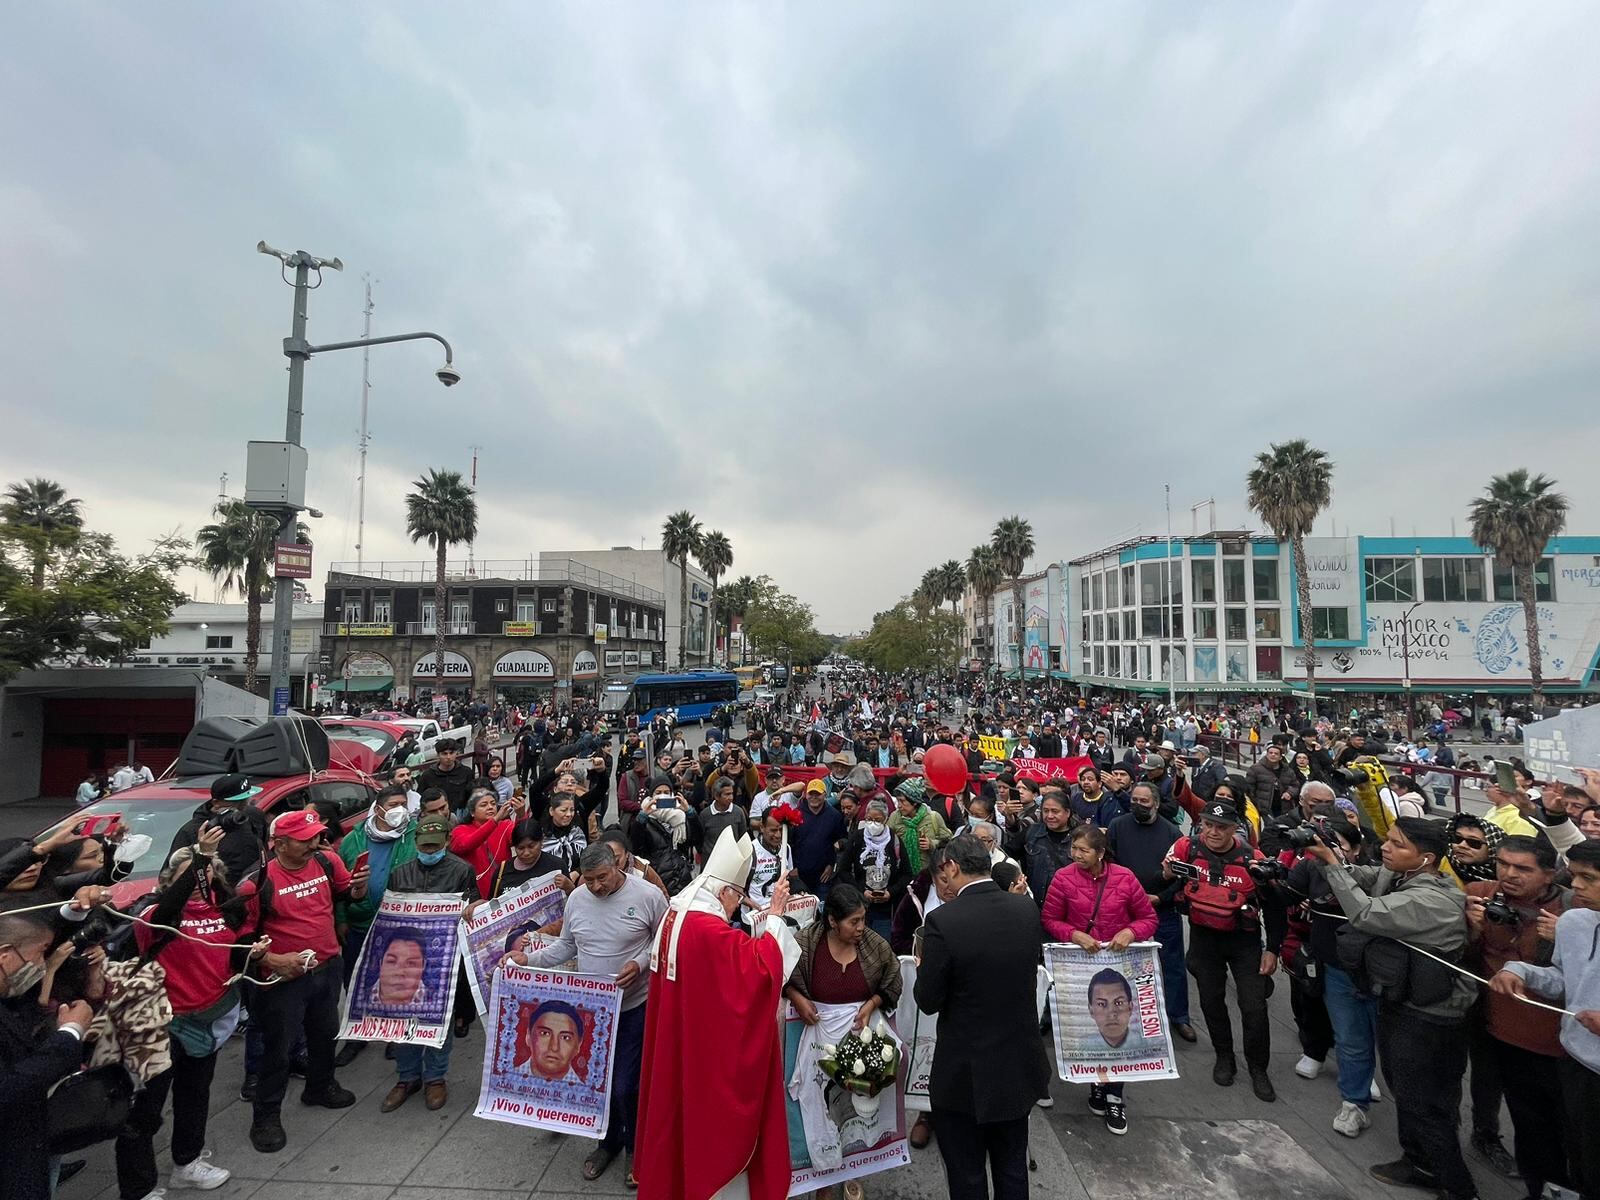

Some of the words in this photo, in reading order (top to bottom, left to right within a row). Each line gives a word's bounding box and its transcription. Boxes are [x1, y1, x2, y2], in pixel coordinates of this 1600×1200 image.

[1382, 619, 1440, 633] AMOR
[417, 663, 469, 673] ZAPTERIA
[496, 662, 550, 673] GUADALUPE
[575, 661, 597, 672] ZAPATERIA
[403, 902, 412, 912] lo
[415, 902, 462, 912] llevaron!
[465, 916, 488, 935] ¡Vivo
[490, 908, 503, 920] se
[505, 902, 515, 912] lo
[502, 967, 531, 981] ¡Vivo
[534, 973, 549, 983] se
[552, 973, 563, 985] lo
[567, 975, 617, 992] llevaron!
[1139, 984, 1157, 1016] FALTAN
[1143, 1017, 1161, 1037] NOS
[1070, 1063, 1096, 1077] ¡Vivo
[1097, 1063, 1108, 1073] lo
[1110, 1059, 1165, 1075] queremos!
[491, 1098, 521, 1113] ¡Vivo
[523, 1102, 534, 1116] lo
[536, 1108, 597, 1128] queremos!
[849, 1144, 905, 1170] queremos!
